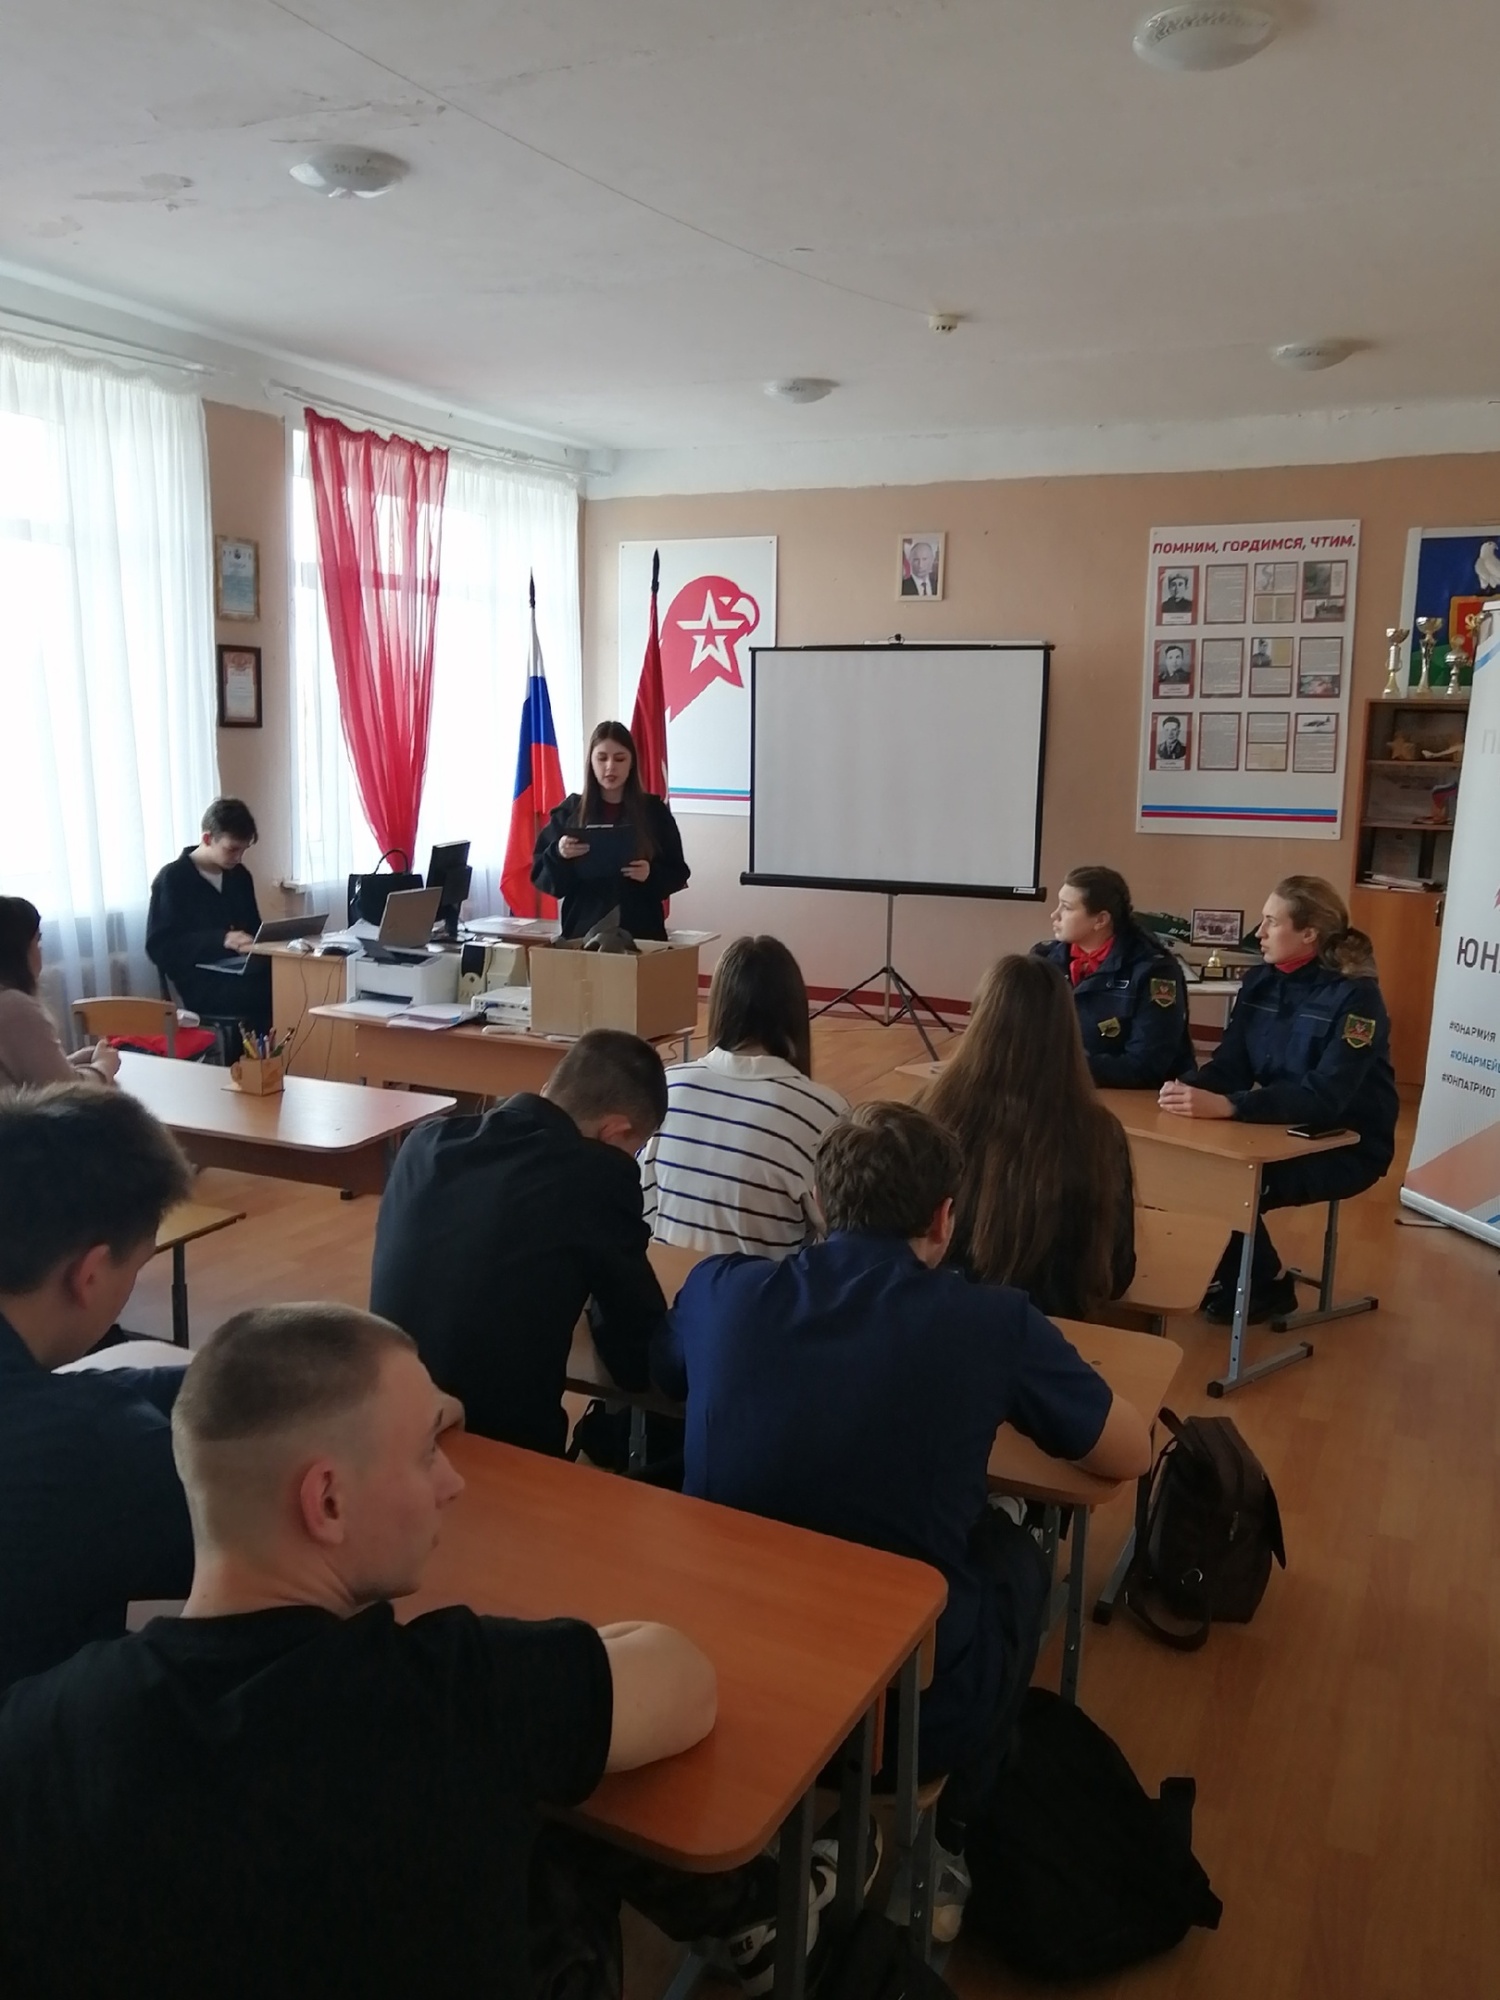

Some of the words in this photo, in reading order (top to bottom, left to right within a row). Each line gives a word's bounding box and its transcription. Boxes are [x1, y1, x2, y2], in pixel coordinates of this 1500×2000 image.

[1152, 541, 1218, 555] ПОМНИМ,
[1223, 537, 1306, 553] ГОРДИМСЯ,
[1310, 535, 1356, 548] ЧТИМ.
[1457, 936, 1500, 974] ЮН
[1449, 1021, 1497, 1042] #ЮНАРМИЯ
[1441, 1072, 1497, 1098] #ЮНПАТРИОТ
